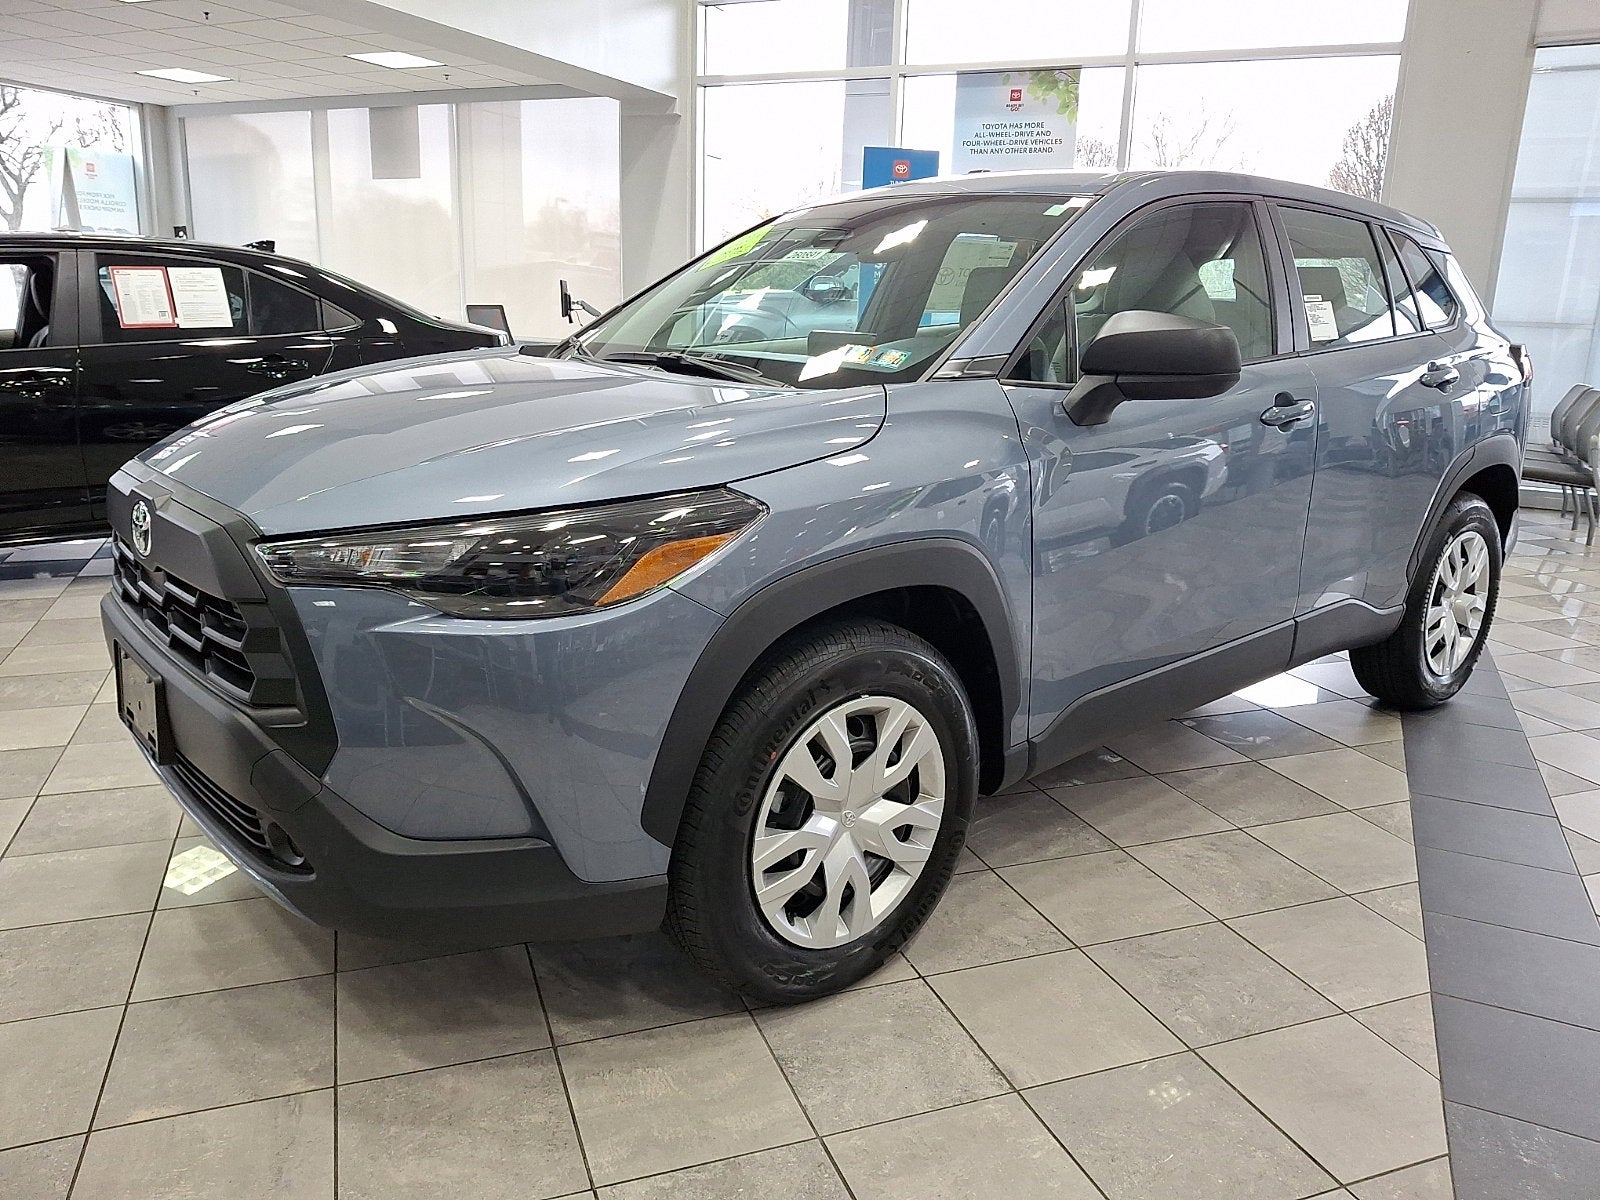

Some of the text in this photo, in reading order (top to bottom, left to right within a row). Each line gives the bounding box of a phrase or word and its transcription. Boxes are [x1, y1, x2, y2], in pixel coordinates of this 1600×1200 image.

[1024, 121, 1045, 129] MORE
[962, 139, 1029, 147] FOUR-WHEEL-DRIVE
[1028, 146, 1055, 154] BRAND.
